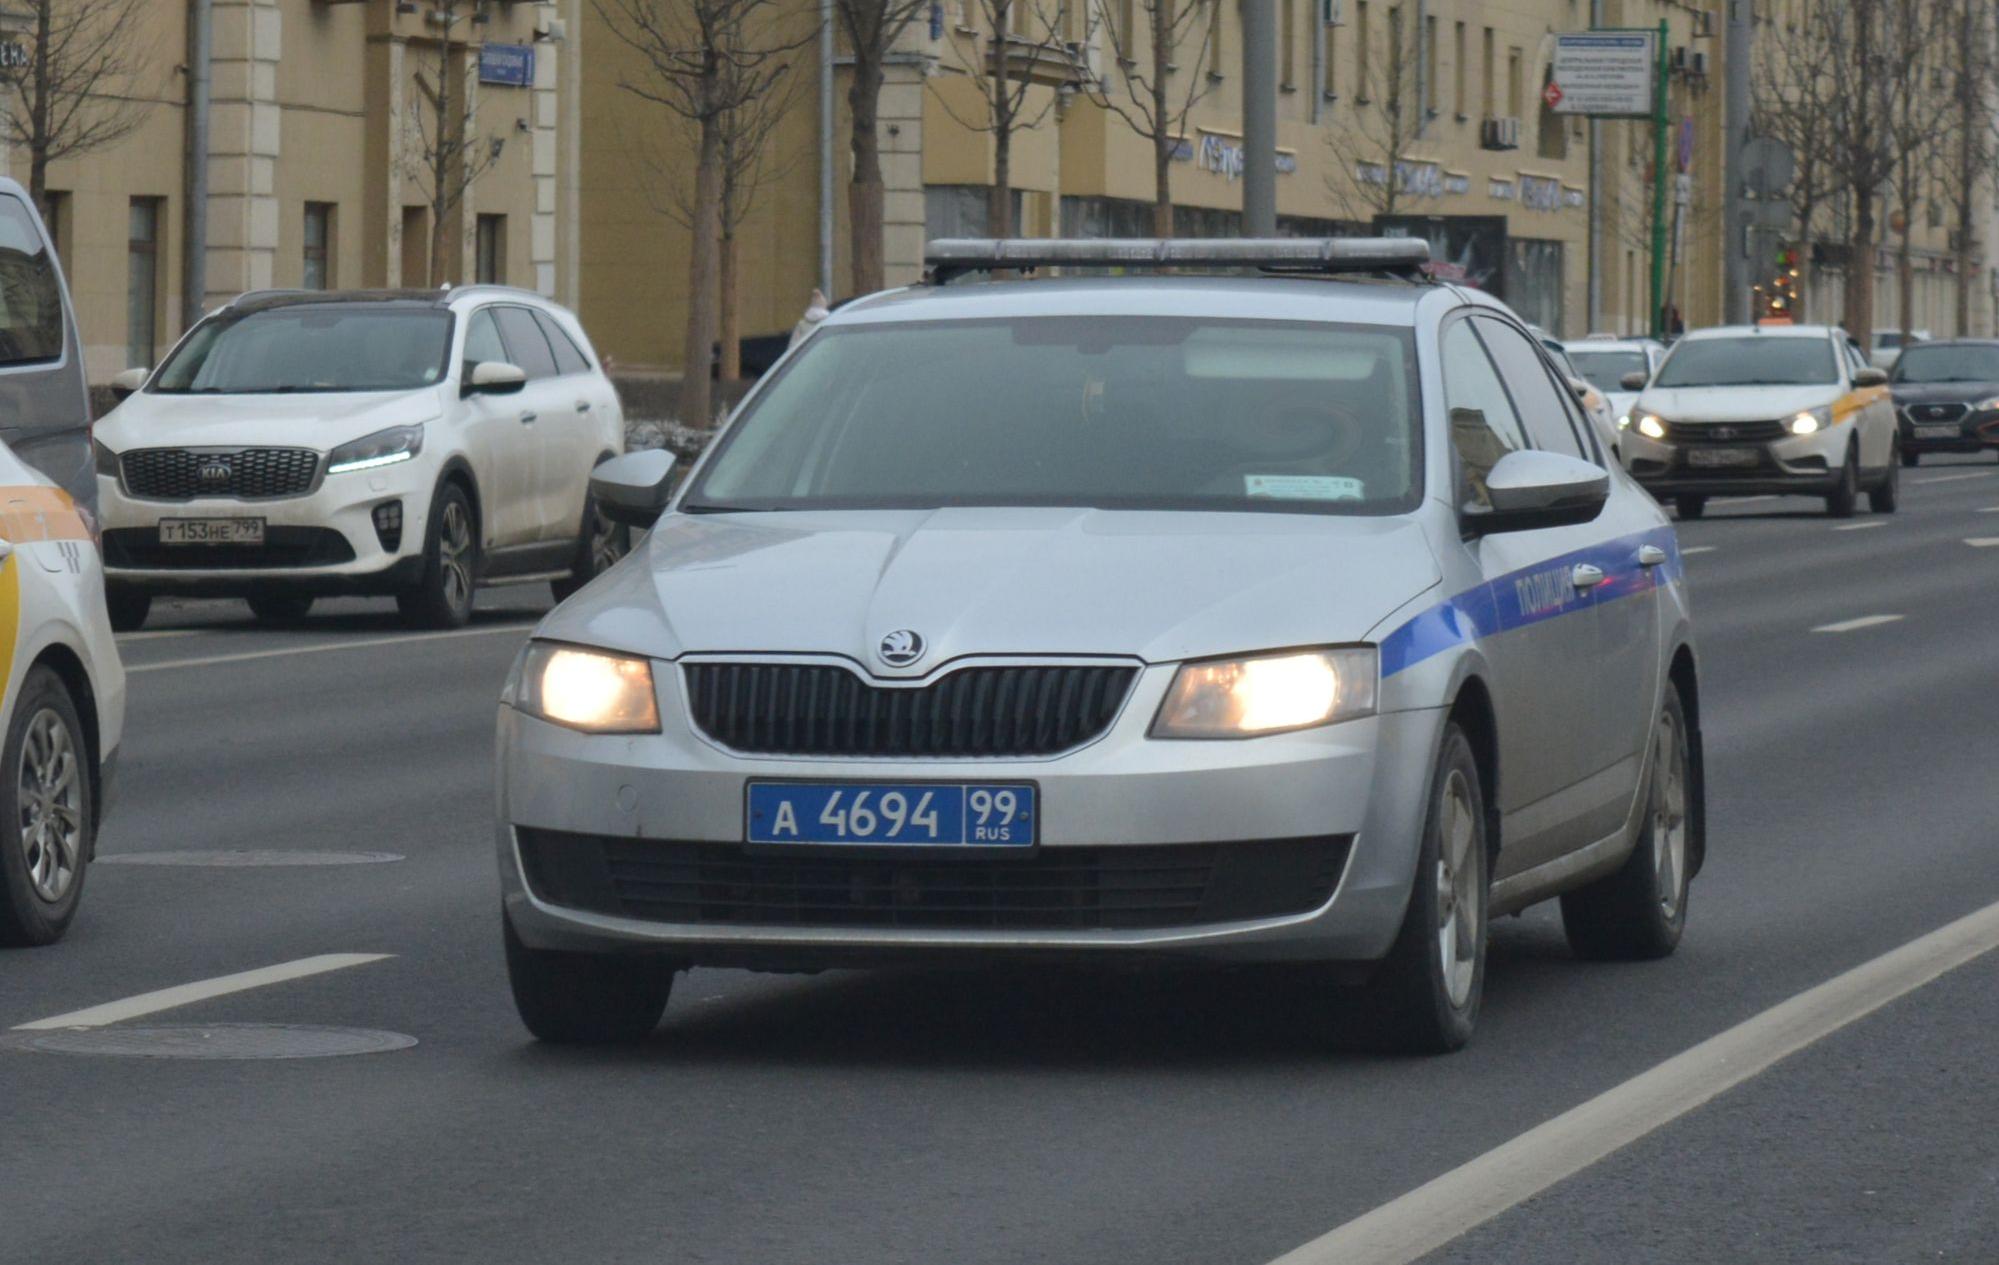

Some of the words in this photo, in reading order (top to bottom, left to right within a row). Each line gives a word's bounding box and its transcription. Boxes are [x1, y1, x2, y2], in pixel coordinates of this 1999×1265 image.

[202, 467, 226, 479] KIA
[1515, 565, 1575, 616] ПОЛИЦИЯ
[772, 801, 798, 836] А
[819, 791, 938, 838] 4694
[969, 790, 1017, 825] 99
[975, 826, 1010, 841] RUS
